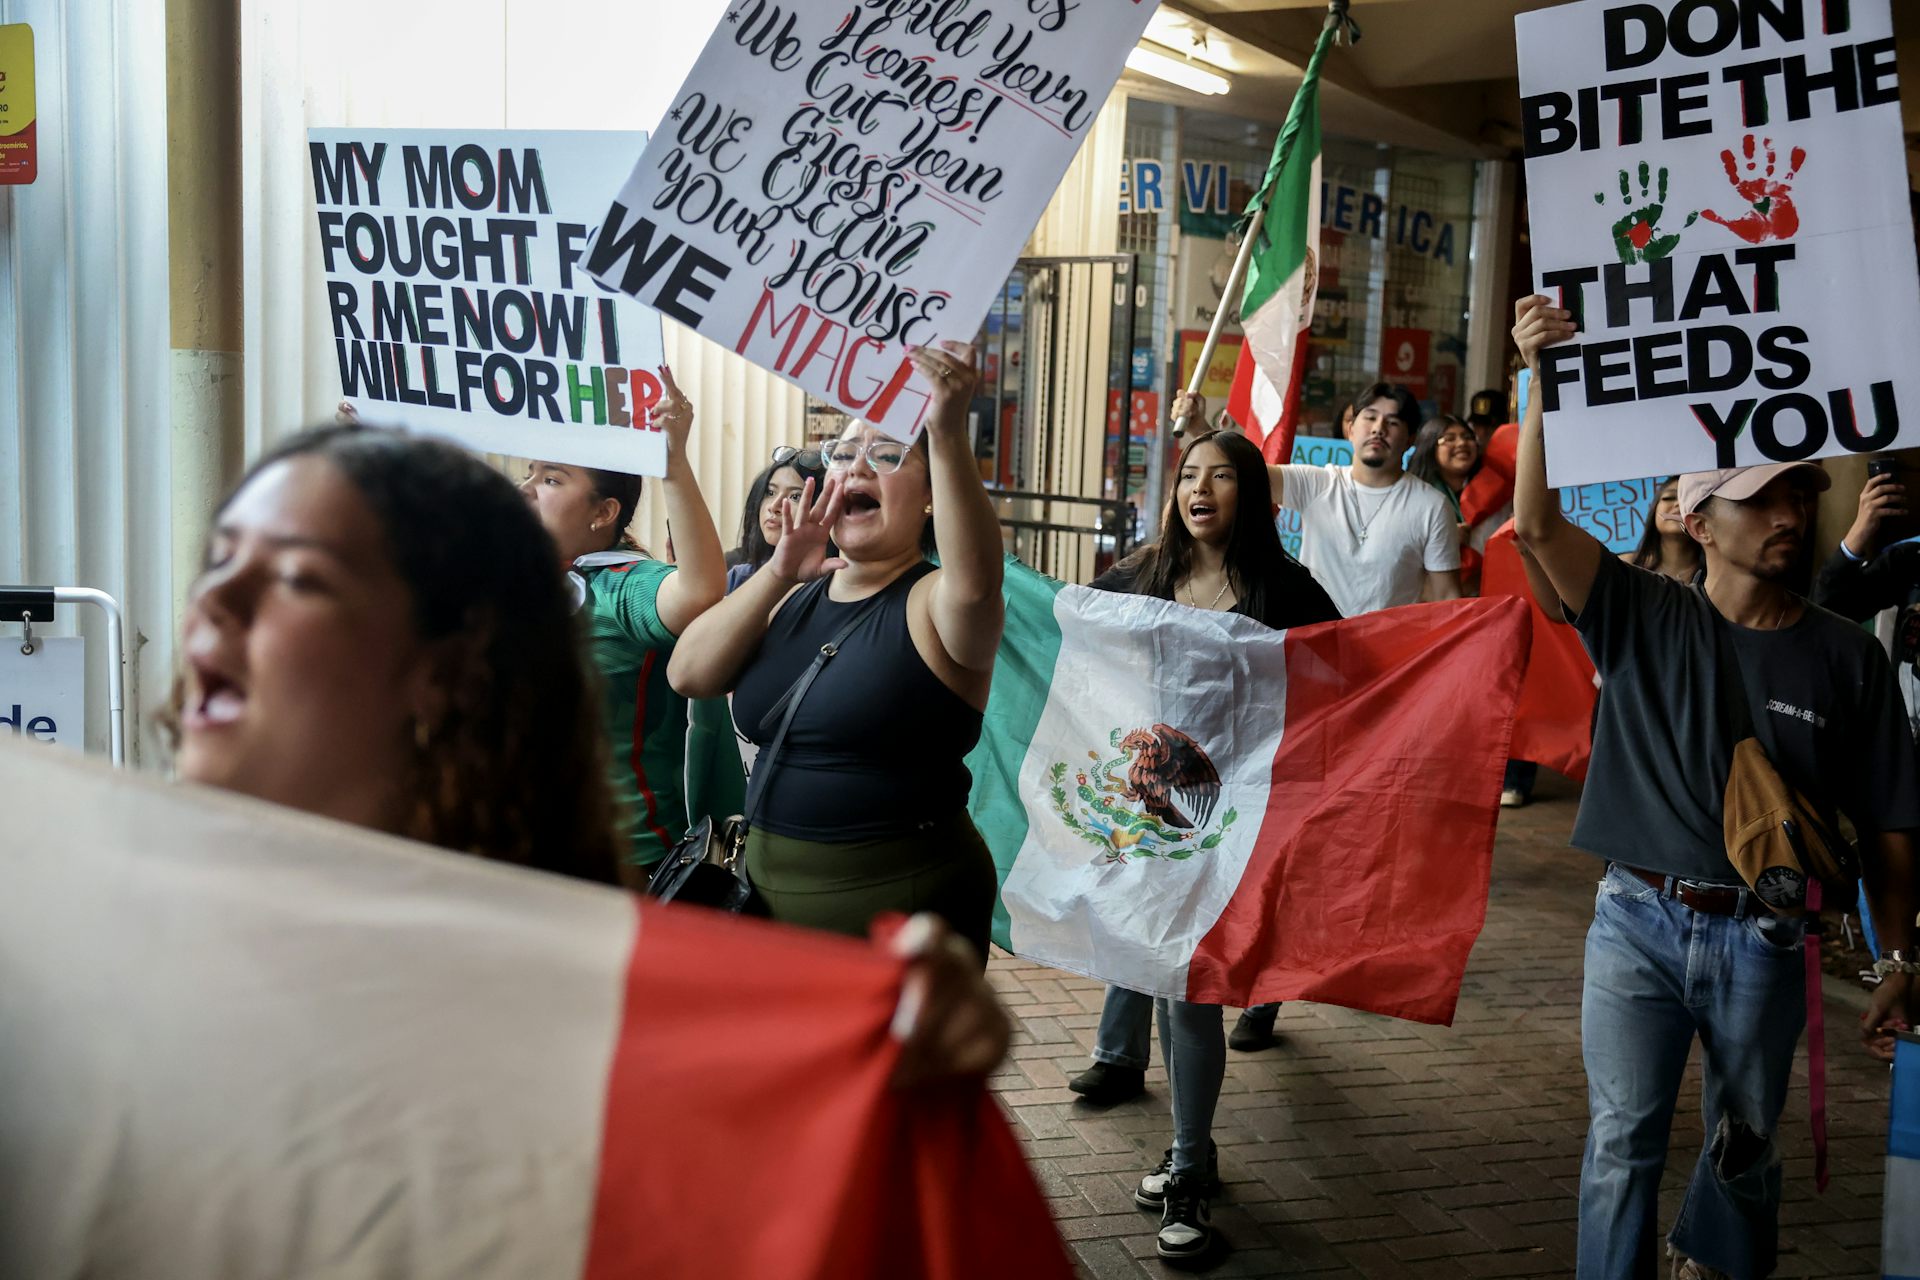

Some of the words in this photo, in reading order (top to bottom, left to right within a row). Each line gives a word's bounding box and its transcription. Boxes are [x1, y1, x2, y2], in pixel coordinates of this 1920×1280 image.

[866, 0, 978, 57] uild
[805, 51, 909, 135] Cut
[819, 5, 1003, 143] Homes!
[1520, 71, 1712, 159] BITE
[1722, 37, 1900, 128] THE
[309, 142, 388, 206] MY
[402, 144, 552, 214] MOM
[782, 106, 921, 223] Grass!
[318, 211, 537, 285] FOUGHT
[1543, 244, 1795, 333] THAT
[327, 281, 366, 340] R
[372, 280, 449, 345] ME
[451, 286, 588, 361] NOW
[598, 297, 620, 365] I
[586, 200, 732, 329] WE
[735, 278, 934, 435] MAGA
[336, 339, 457, 409] WILL
[455, 350, 565, 423] FOR
[566, 364, 664, 433] HER
[1539, 325, 1811, 412] FEEDS
[1689, 381, 1900, 469] YOU
